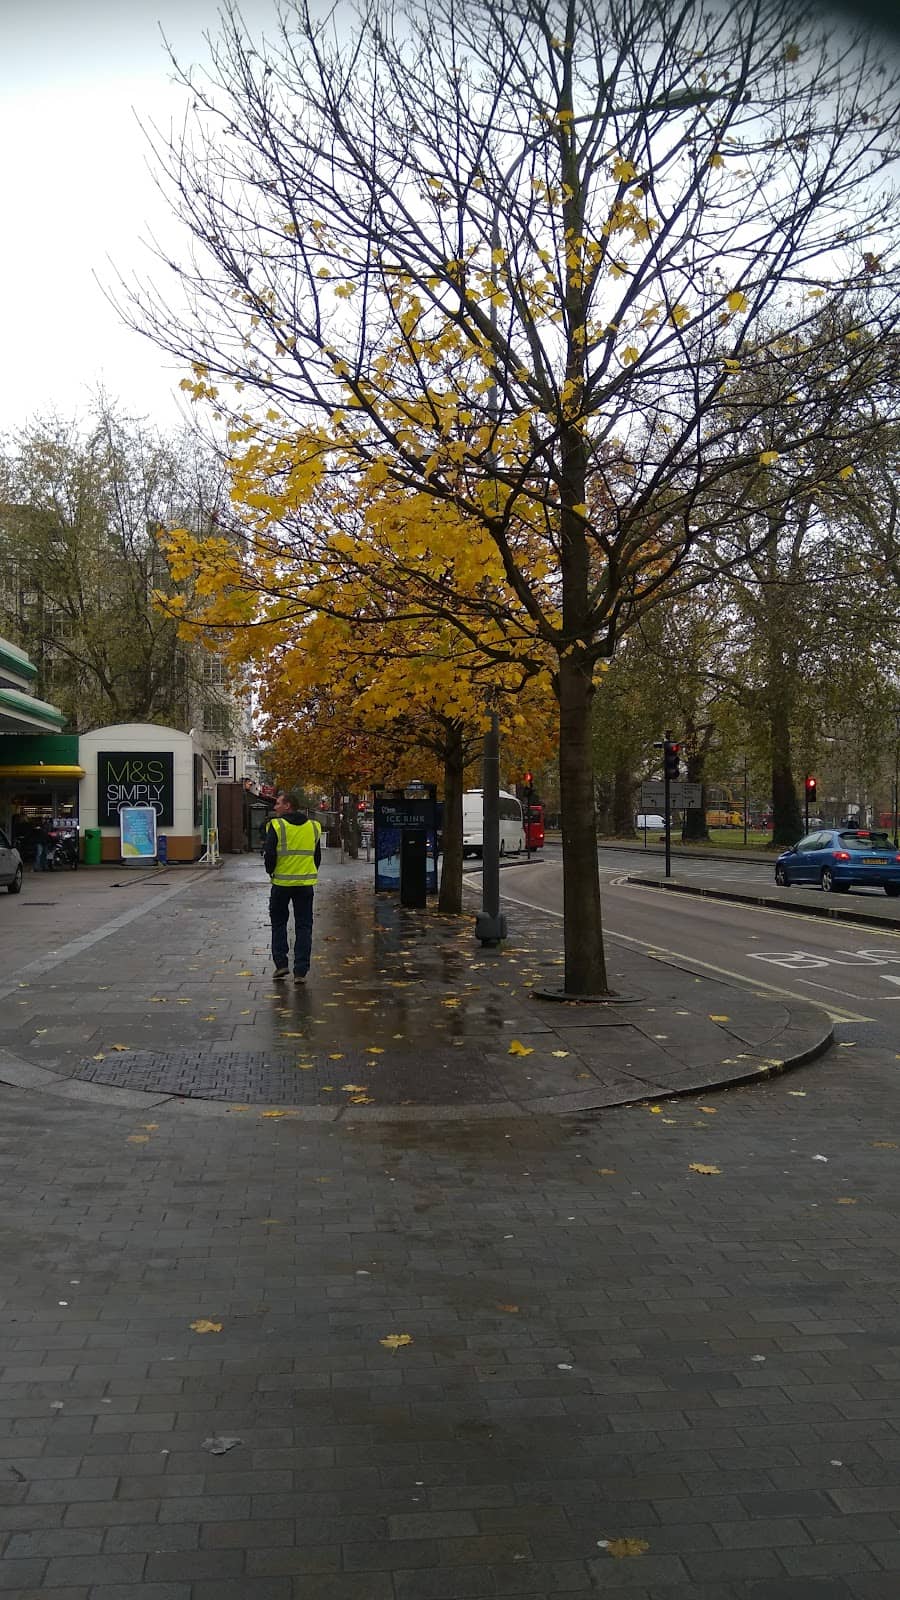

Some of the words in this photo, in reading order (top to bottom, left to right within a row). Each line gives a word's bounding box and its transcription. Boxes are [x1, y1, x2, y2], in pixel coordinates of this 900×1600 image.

[107, 760, 164, 783] M&S
[106, 784, 165, 801] SIMPLY
[386, 815, 401, 823] ICE
